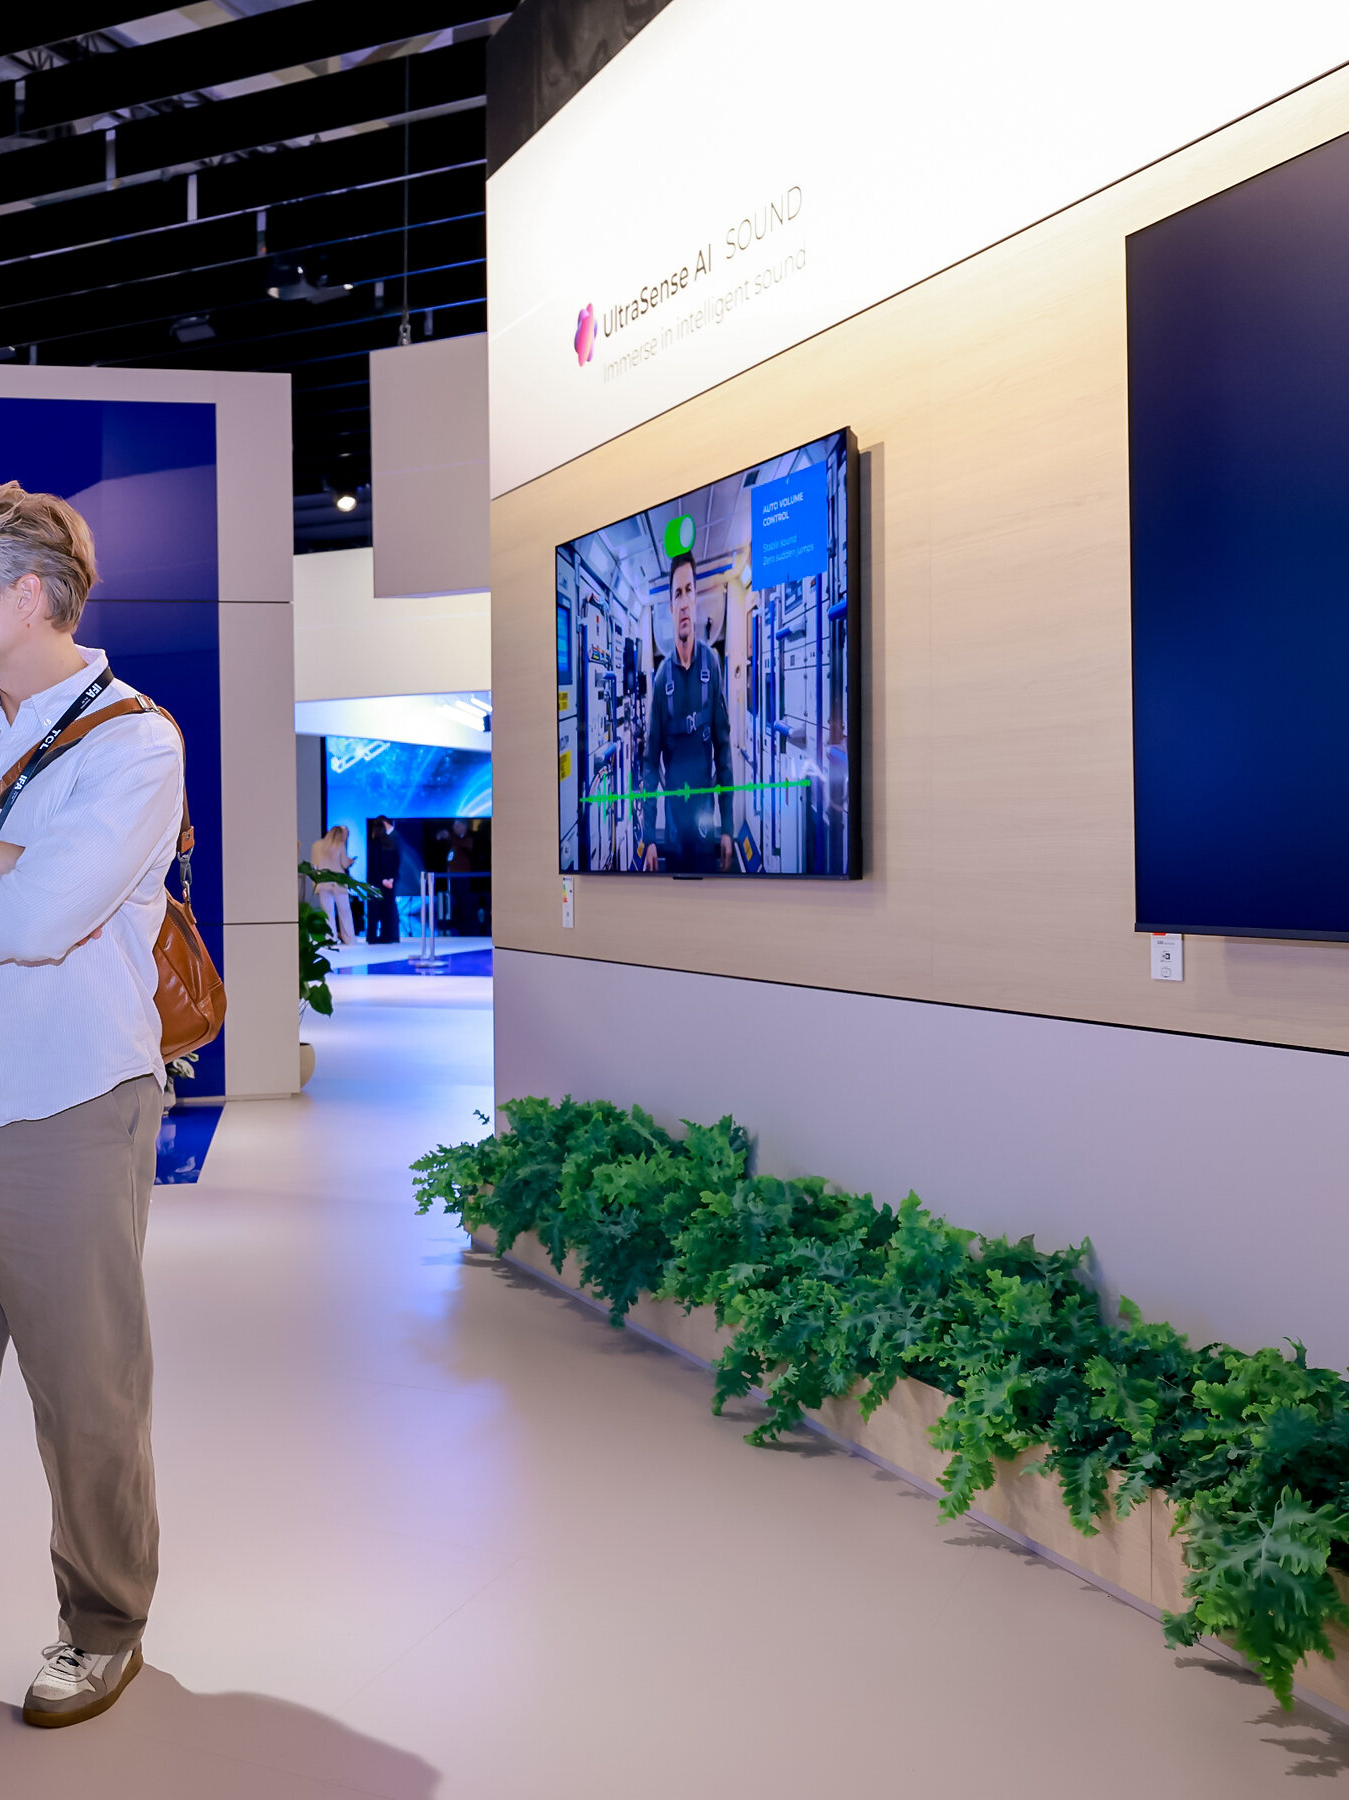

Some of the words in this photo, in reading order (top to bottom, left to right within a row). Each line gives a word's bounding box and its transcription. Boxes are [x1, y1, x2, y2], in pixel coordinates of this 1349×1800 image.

[603, 266, 689, 338] UltraSense
[694, 244, 712, 281] AI
[726, 186, 802, 260] SOUND
[604, 335, 658, 384] Immerse
[660, 325, 673, 352] in
[676, 280, 751, 341] intelligent
[754, 244, 807, 295] sound
[762, 501, 779, 514] AUTO
[779, 492, 804, 508] VOLUME
[762, 511, 790, 527] CONTROL
[85, 682, 103, 698] IFA
[39, 728, 61, 750] TCL
[14, 774, 28, 791] IFA
